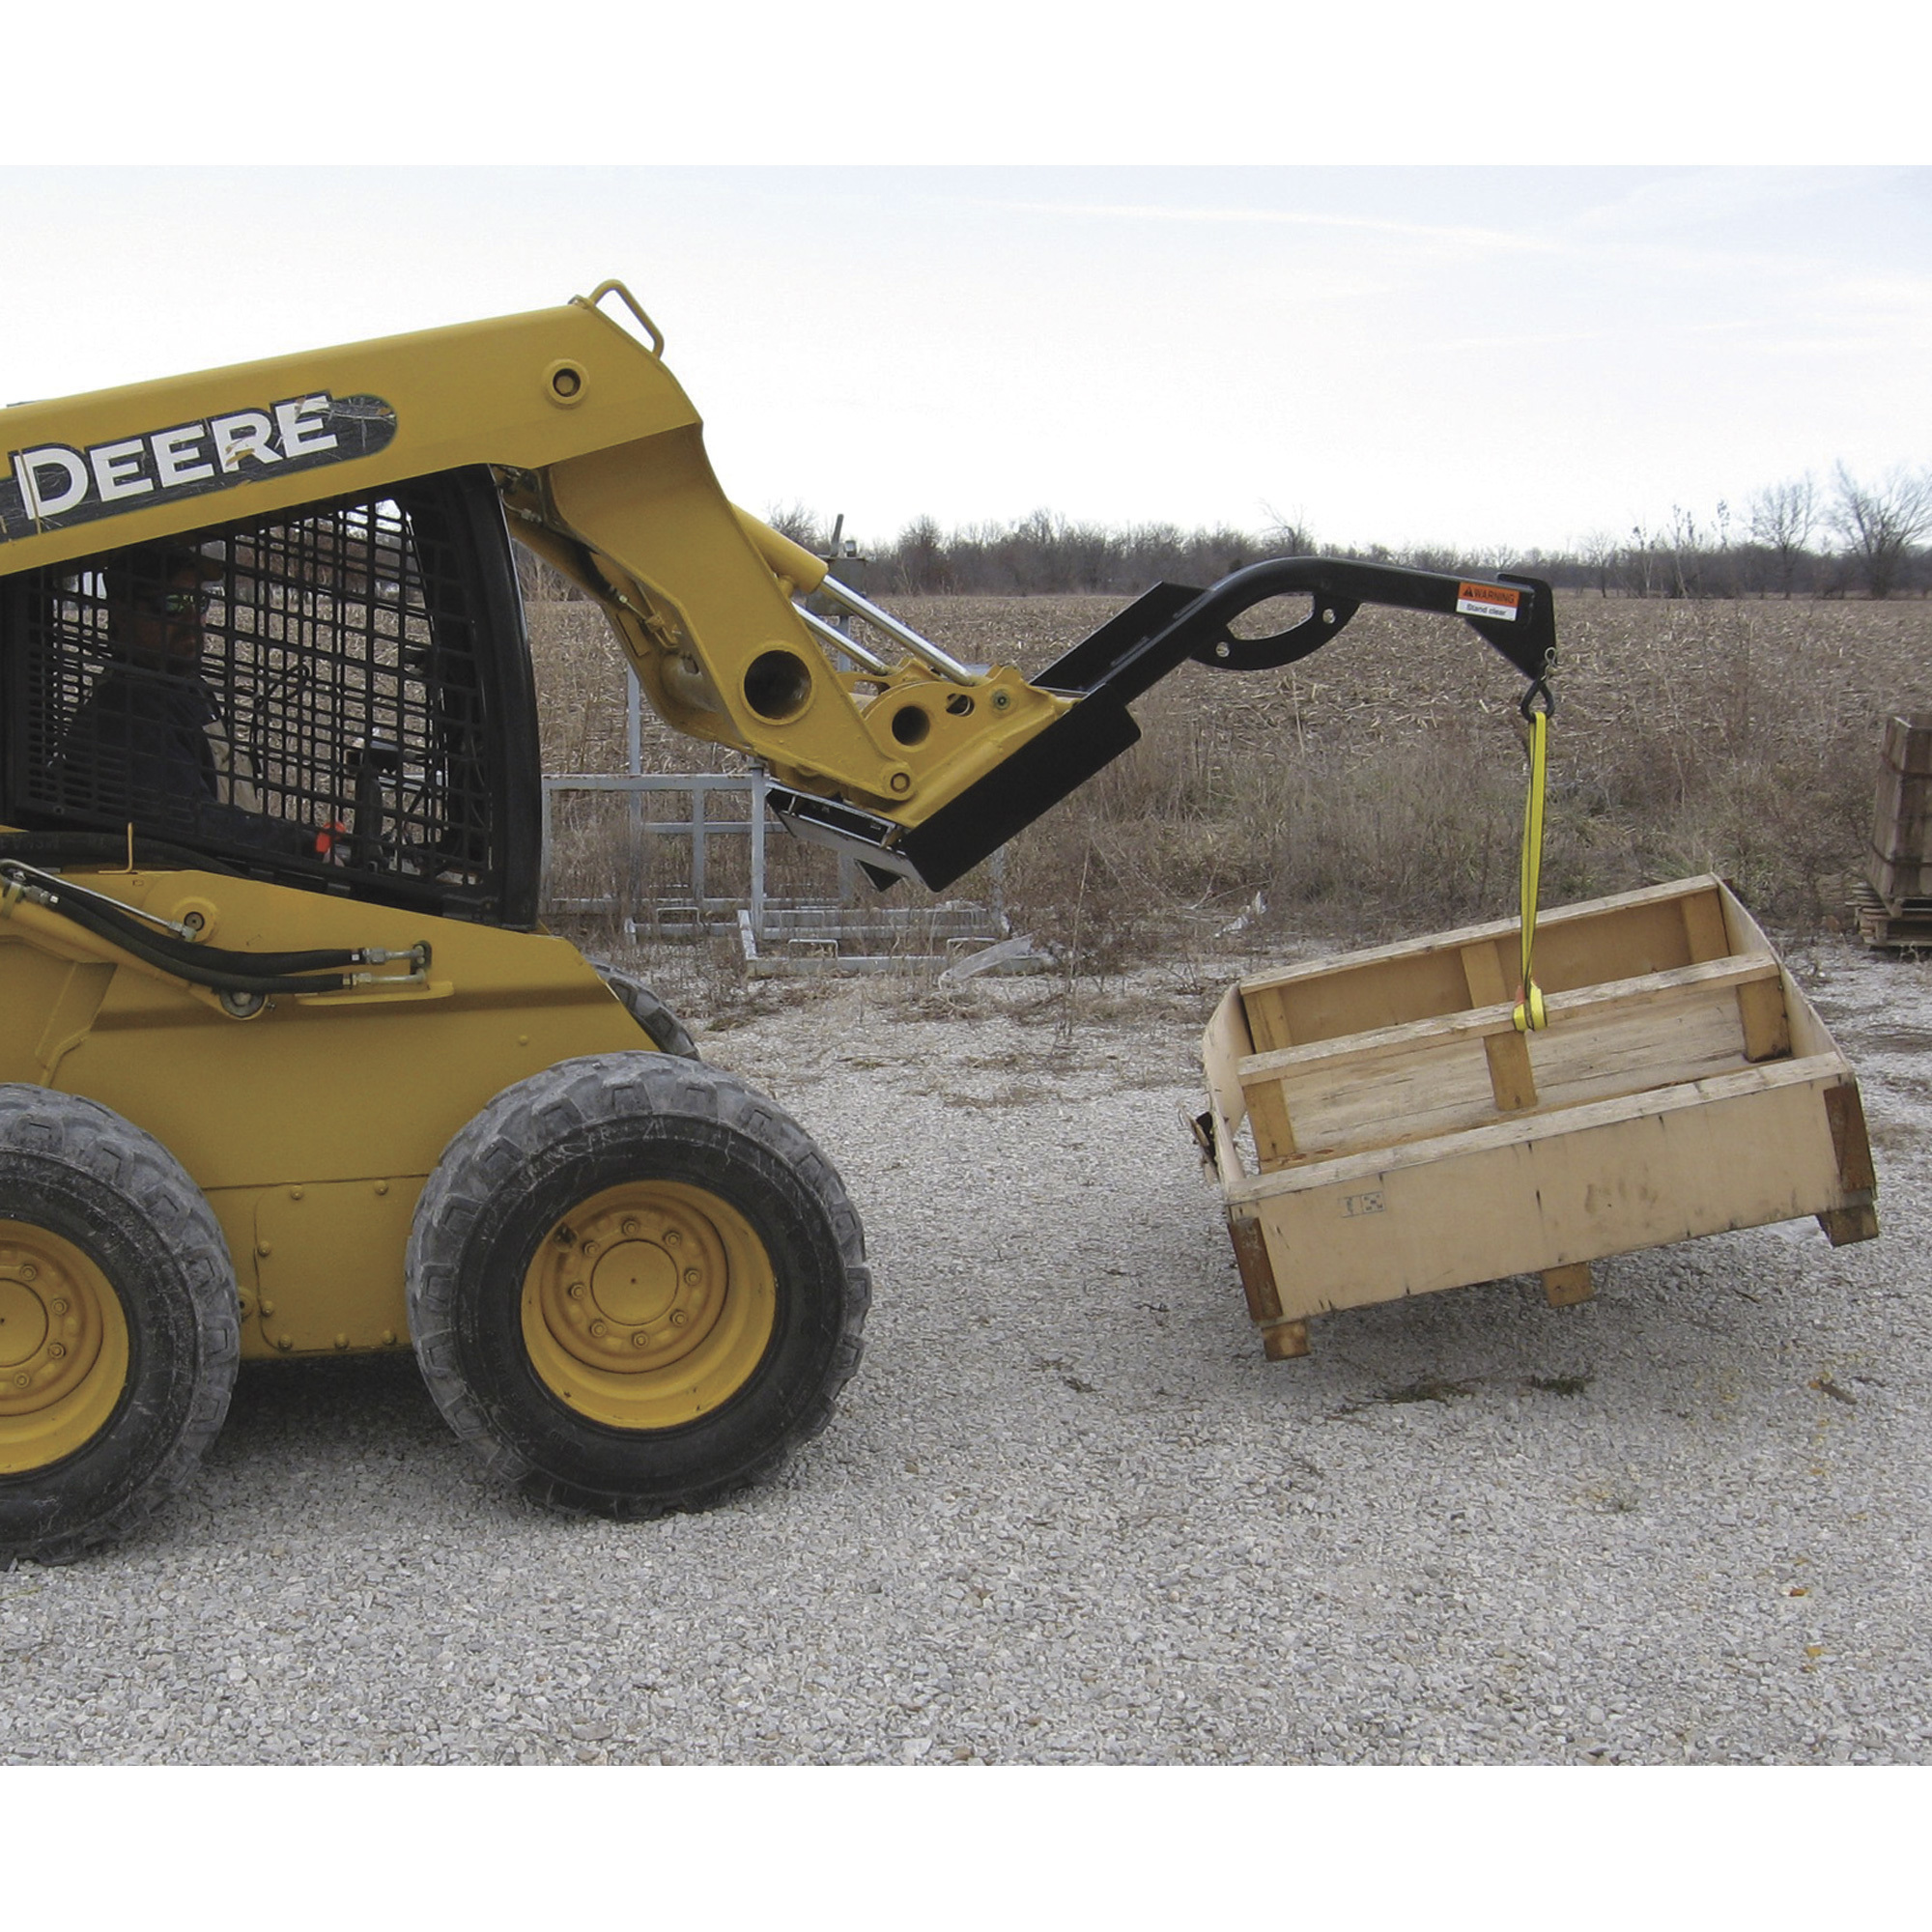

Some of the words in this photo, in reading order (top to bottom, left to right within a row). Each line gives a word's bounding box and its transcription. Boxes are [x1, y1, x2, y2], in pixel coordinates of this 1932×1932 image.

[13, 395, 339, 520] DEERE
[1474, 589, 1515, 604] WARNING
[1466, 603, 1488, 613] Stand
[1489, 608, 1507, 616] clear
